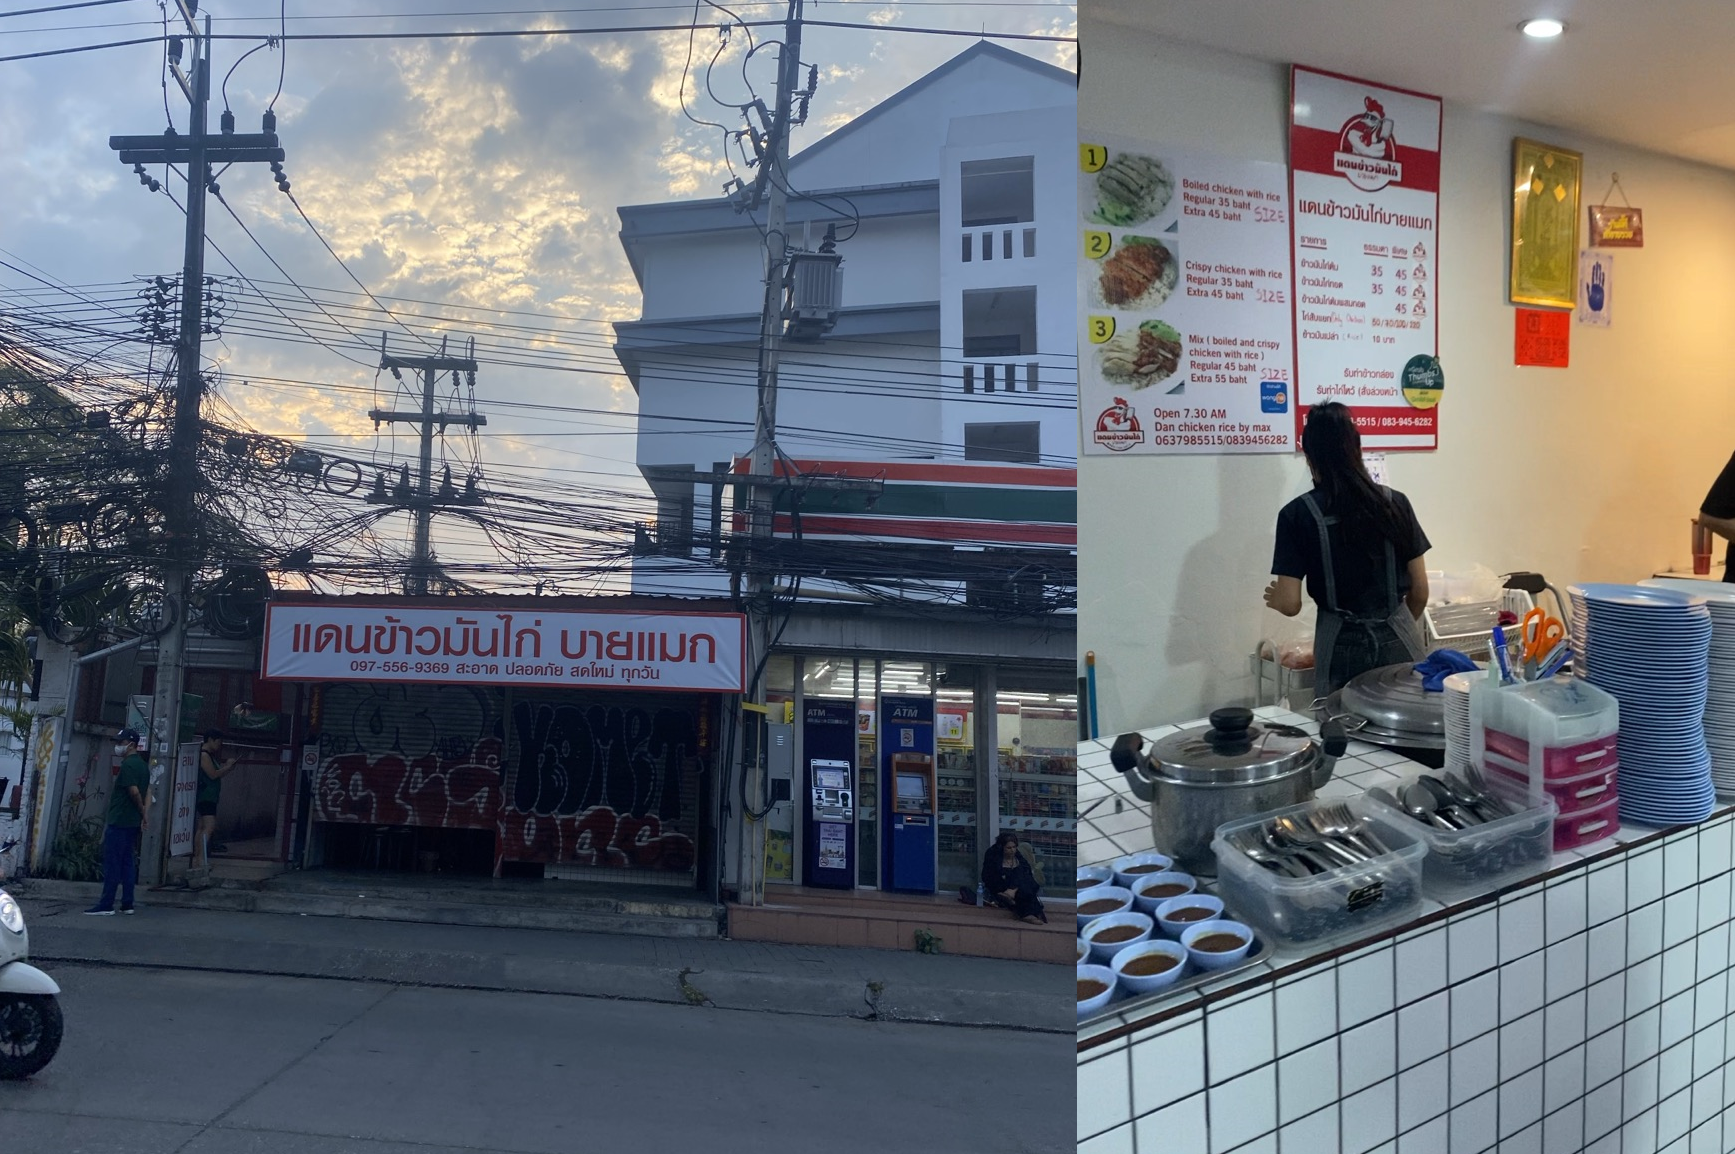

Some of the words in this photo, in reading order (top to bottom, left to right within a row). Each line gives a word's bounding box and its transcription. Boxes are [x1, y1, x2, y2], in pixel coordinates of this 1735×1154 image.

[1087, 148, 1097, 167] 1
[1182, 178, 1210, 191] Boiled
[1212, 183, 1244, 197] chicken
[1246, 187, 1264, 199] with
[1266, 191, 1281, 202] rice
[1183, 192, 1215, 206] Regular
[1218, 197, 1230, 206] 35
[1232, 199, 1251, 211] baht
[1184, 205, 1205, 217] Extra
[1208, 208, 1220, 218] 45
[1223, 210, 1241, 222] baht
[1254, 206, 1285, 223] SIZE
[1299, 199, 1432, 231] แดนข้าวมันไก่บายแมก
[1091, 235, 1103, 252] 2
[1185, 260, 1212, 273] Crispy
[1214, 264, 1246, 276] chicken
[1248, 267, 1266, 278] with
[1268, 270, 1283, 279] rice
[1371, 265, 1383, 277] 35
[1395, 269, 1407, 280] 45
[1186, 274, 1218, 287] Regular
[1221, 277, 1233, 287] 35
[1235, 279, 1253, 289] baht
[1187, 287, 1208, 298] Extra
[1211, 289, 1223, 299] 45
[1225, 290, 1244, 300] baht
[1371, 284, 1383, 295] 35
[1395, 286, 1407, 297] 45
[1395, 303, 1407, 315] 45
[1095, 320, 1107, 337] 3
[1189, 334, 1204, 344] Mix
[1212, 336, 1238, 346] boiled
[1239, 338, 1255, 347] and
[1257, 340, 1280, 350] crispy
[1372, 335, 1381, 343] 10
[1189, 349, 1222, 359] chicken
[1224, 351, 1242, 360] with
[1244, 351, 1259, 360] rice
[1190, 361, 1222, 372] Regular
[1224, 362, 1236, 371] 45
[1238, 362, 1256, 372] baht
[1190, 373, 1212, 383] Extra
[1215, 374, 1227, 383] 55
[1229, 375, 1248, 384] baht
[1260, 368, 1288, 381] SIZE
[1153, 408, 1180, 421] Open
[1183, 408, 1208, 419] 7.30
[1210, 409, 1226, 419] AM
[1155, 422, 1175, 432] Dan
[1178, 422, 1215, 432] chicken
[1218, 422, 1235, 432] rice
[1238, 423, 1250, 434] by
[1252, 424, 1271, 432] max
[1382, 417, 1433, 426] 083-945-6282
[1155, 435, 1289, 446] 0637985515/0839456282
[292, 614, 542, 658] แดนข้าวมันไก่
[560, 629, 716, 664] บายแมก
[350, 660, 450, 675] 097-556-9369
[455, 662, 499, 676] สะอาด
[505, 661, 564, 678] ปลอดภัย
[570, 661, 614, 679] สดใหม่
[621, 665, 660, 683] ทุกวัน
[807, 708, 826, 717] ATM
[893, 708, 918, 718] ATM
[182, 755, 195, 767] ลาน
